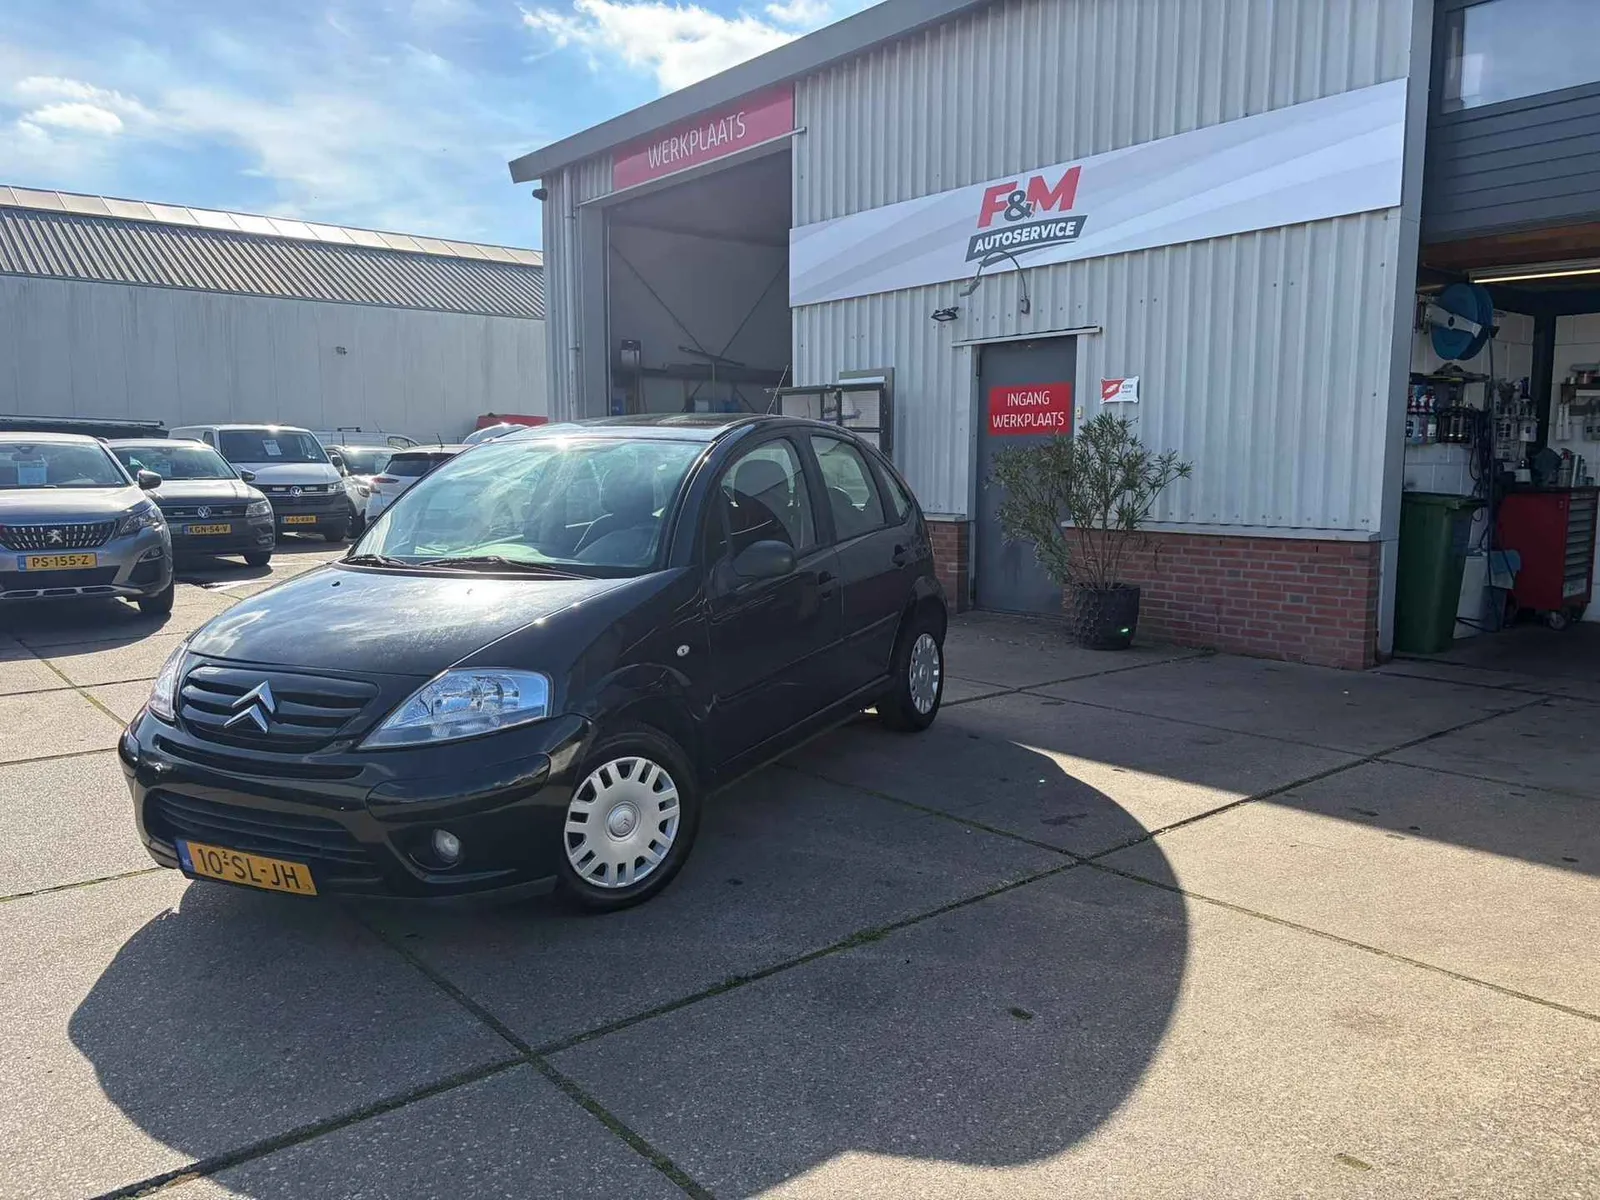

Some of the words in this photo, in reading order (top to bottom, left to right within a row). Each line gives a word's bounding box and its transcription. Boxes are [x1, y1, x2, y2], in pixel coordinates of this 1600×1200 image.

[647, 111, 746, 169] WERKPLAATS
[977, 165, 1082, 228] F&M
[973, 221, 1077, 253] AUTOSERVICE
[1007, 390, 1051, 407] INGANG
[992, 411, 1065, 428] WERKPLAATS
[32, 555, 89, 567] PS-155-Z
